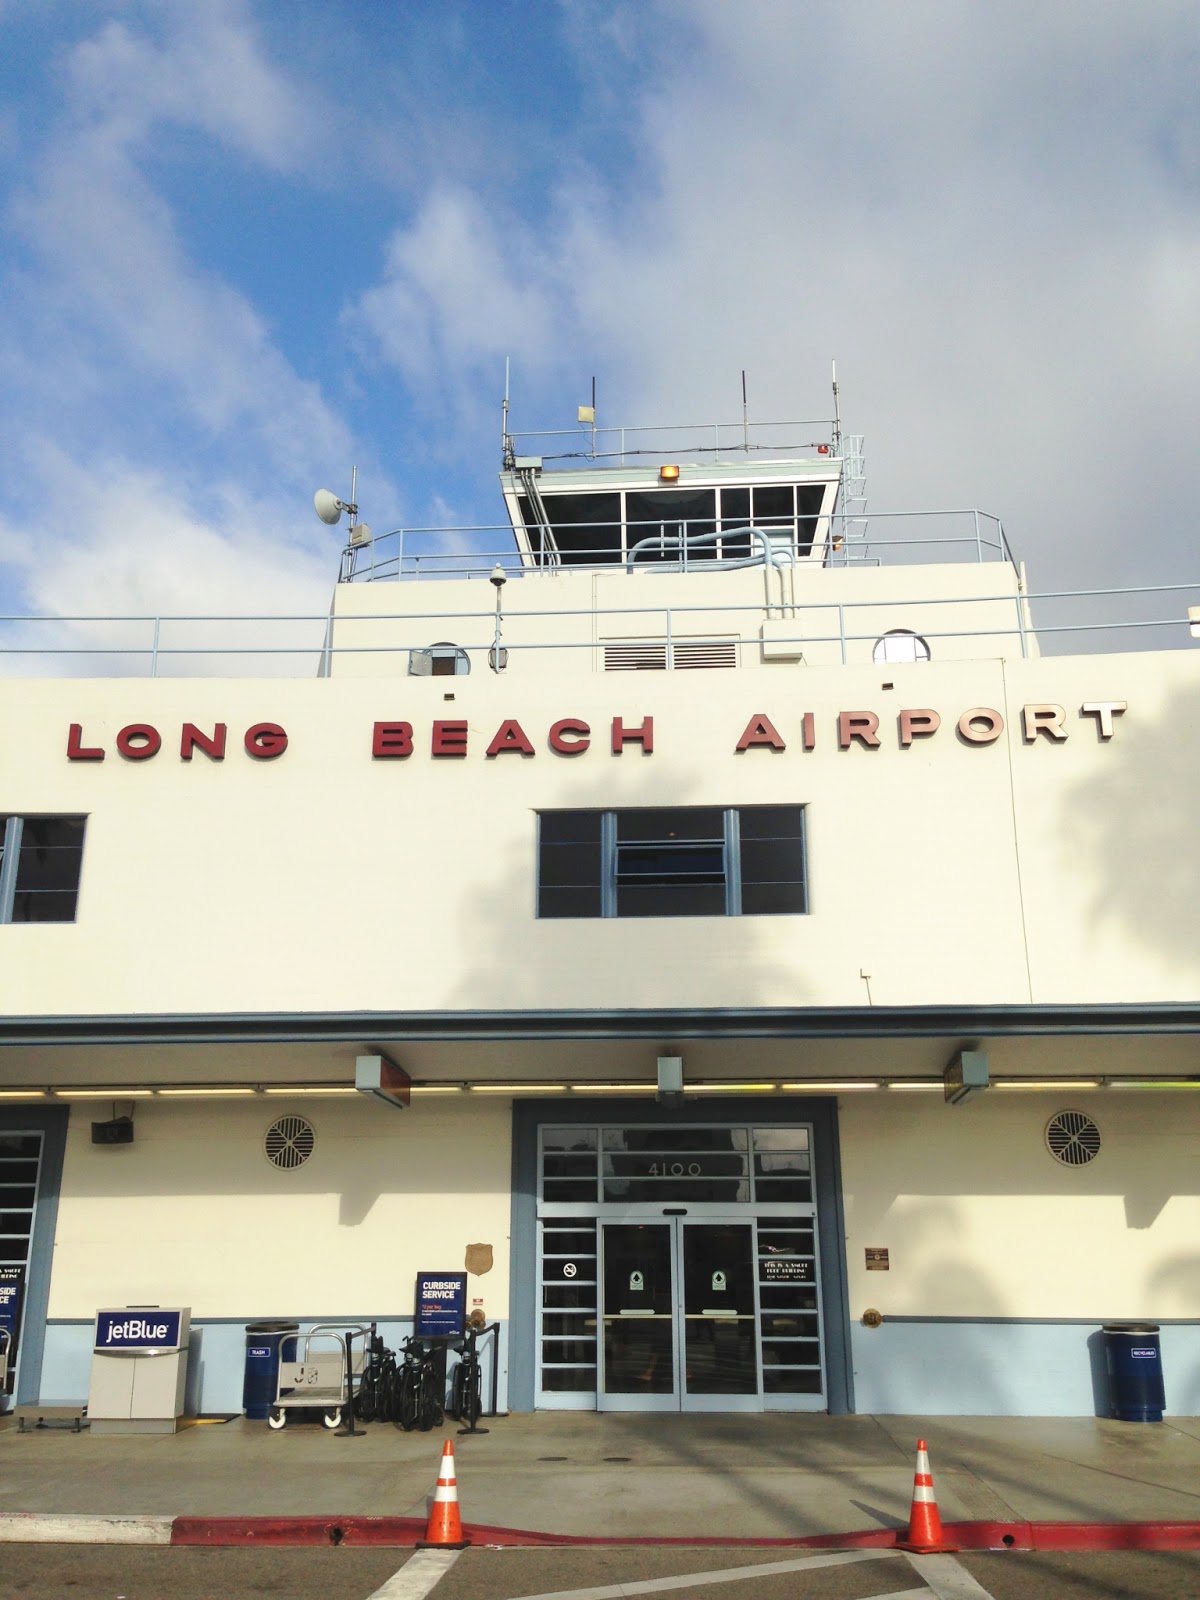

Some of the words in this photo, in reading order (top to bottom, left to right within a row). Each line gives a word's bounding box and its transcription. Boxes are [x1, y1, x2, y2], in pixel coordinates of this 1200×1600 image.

[67, 722, 288, 761] LONG
[372, 717, 653, 759] BEACH
[735, 701, 1127, 751] AIRPORT
[648, 1162, 702, 1177] 4100
[422, 1281, 461, 1290] CURBSIDE
[422, 1290, 455, 1299] SERVICE
[105, 1320, 167, 1343] jetBlue
